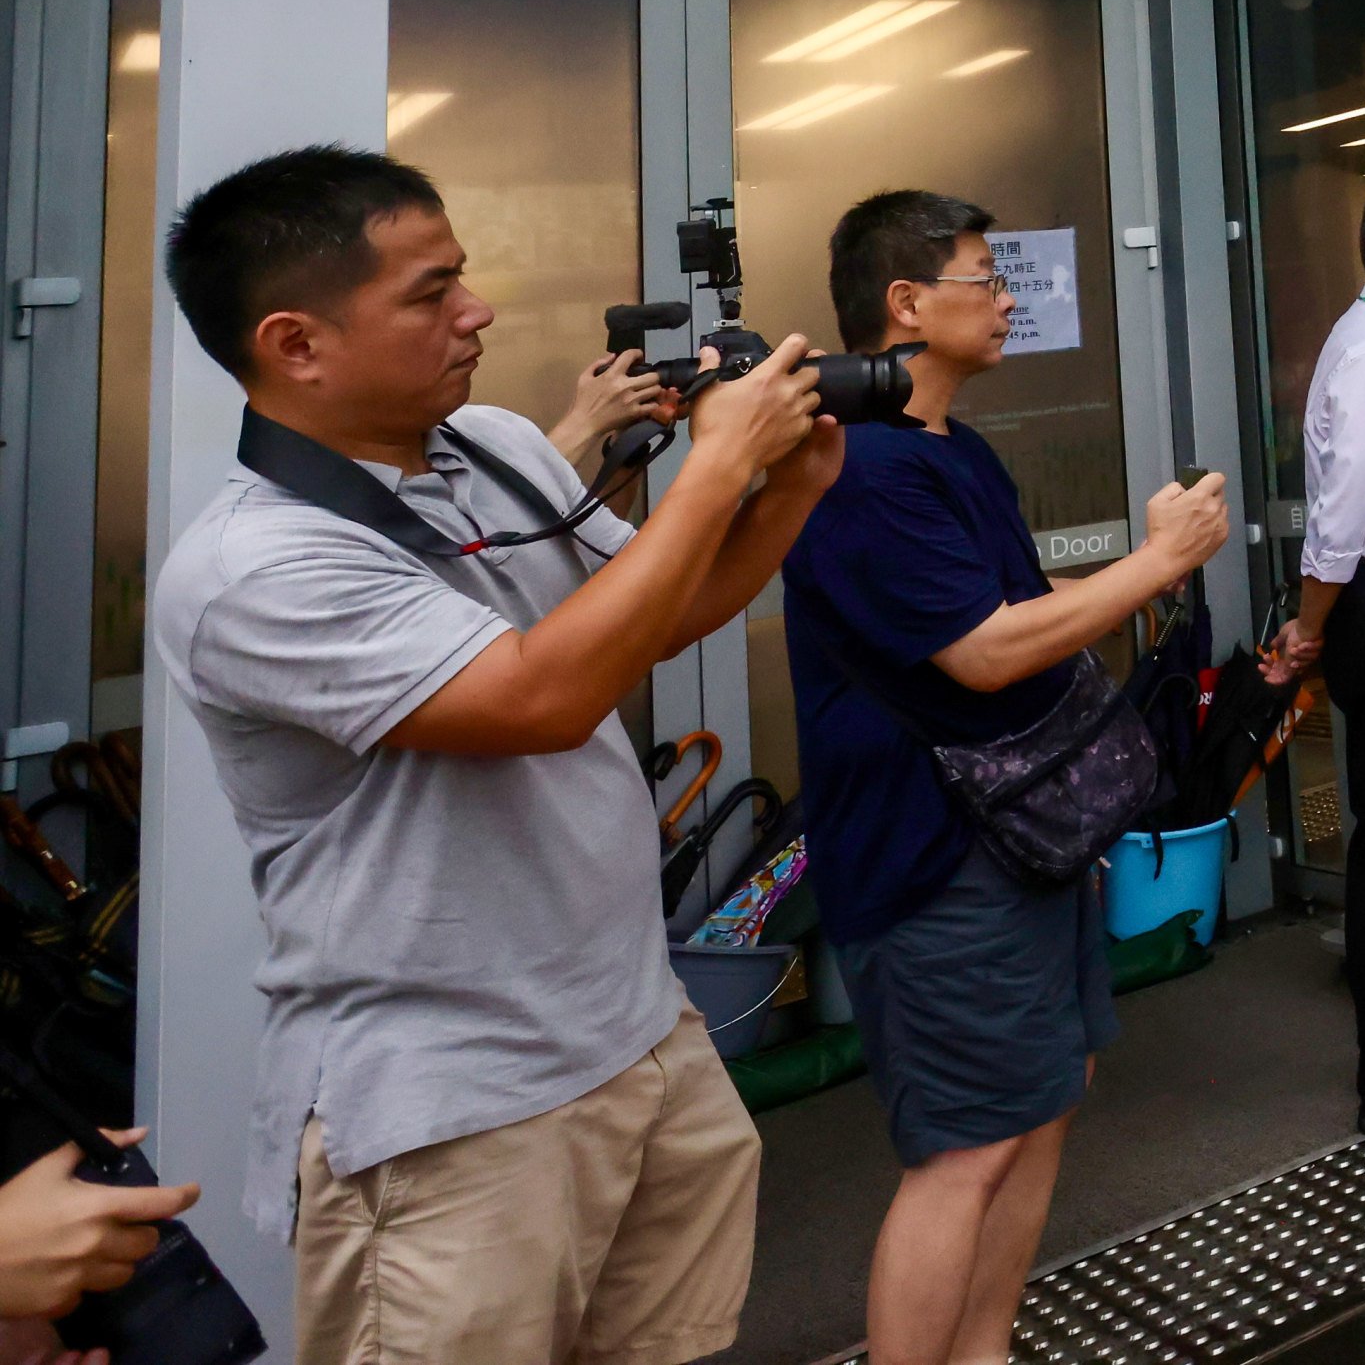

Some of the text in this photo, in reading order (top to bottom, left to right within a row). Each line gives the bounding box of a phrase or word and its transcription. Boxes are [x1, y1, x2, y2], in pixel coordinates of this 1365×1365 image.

[991, 241, 1021, 256] 時間
[1009, 280, 1054, 293] 四十五分
[1018, 318, 1037, 326] a.m.
[1021, 331, 1041, 340] p.m.
[1050, 533, 1113, 560] Door
